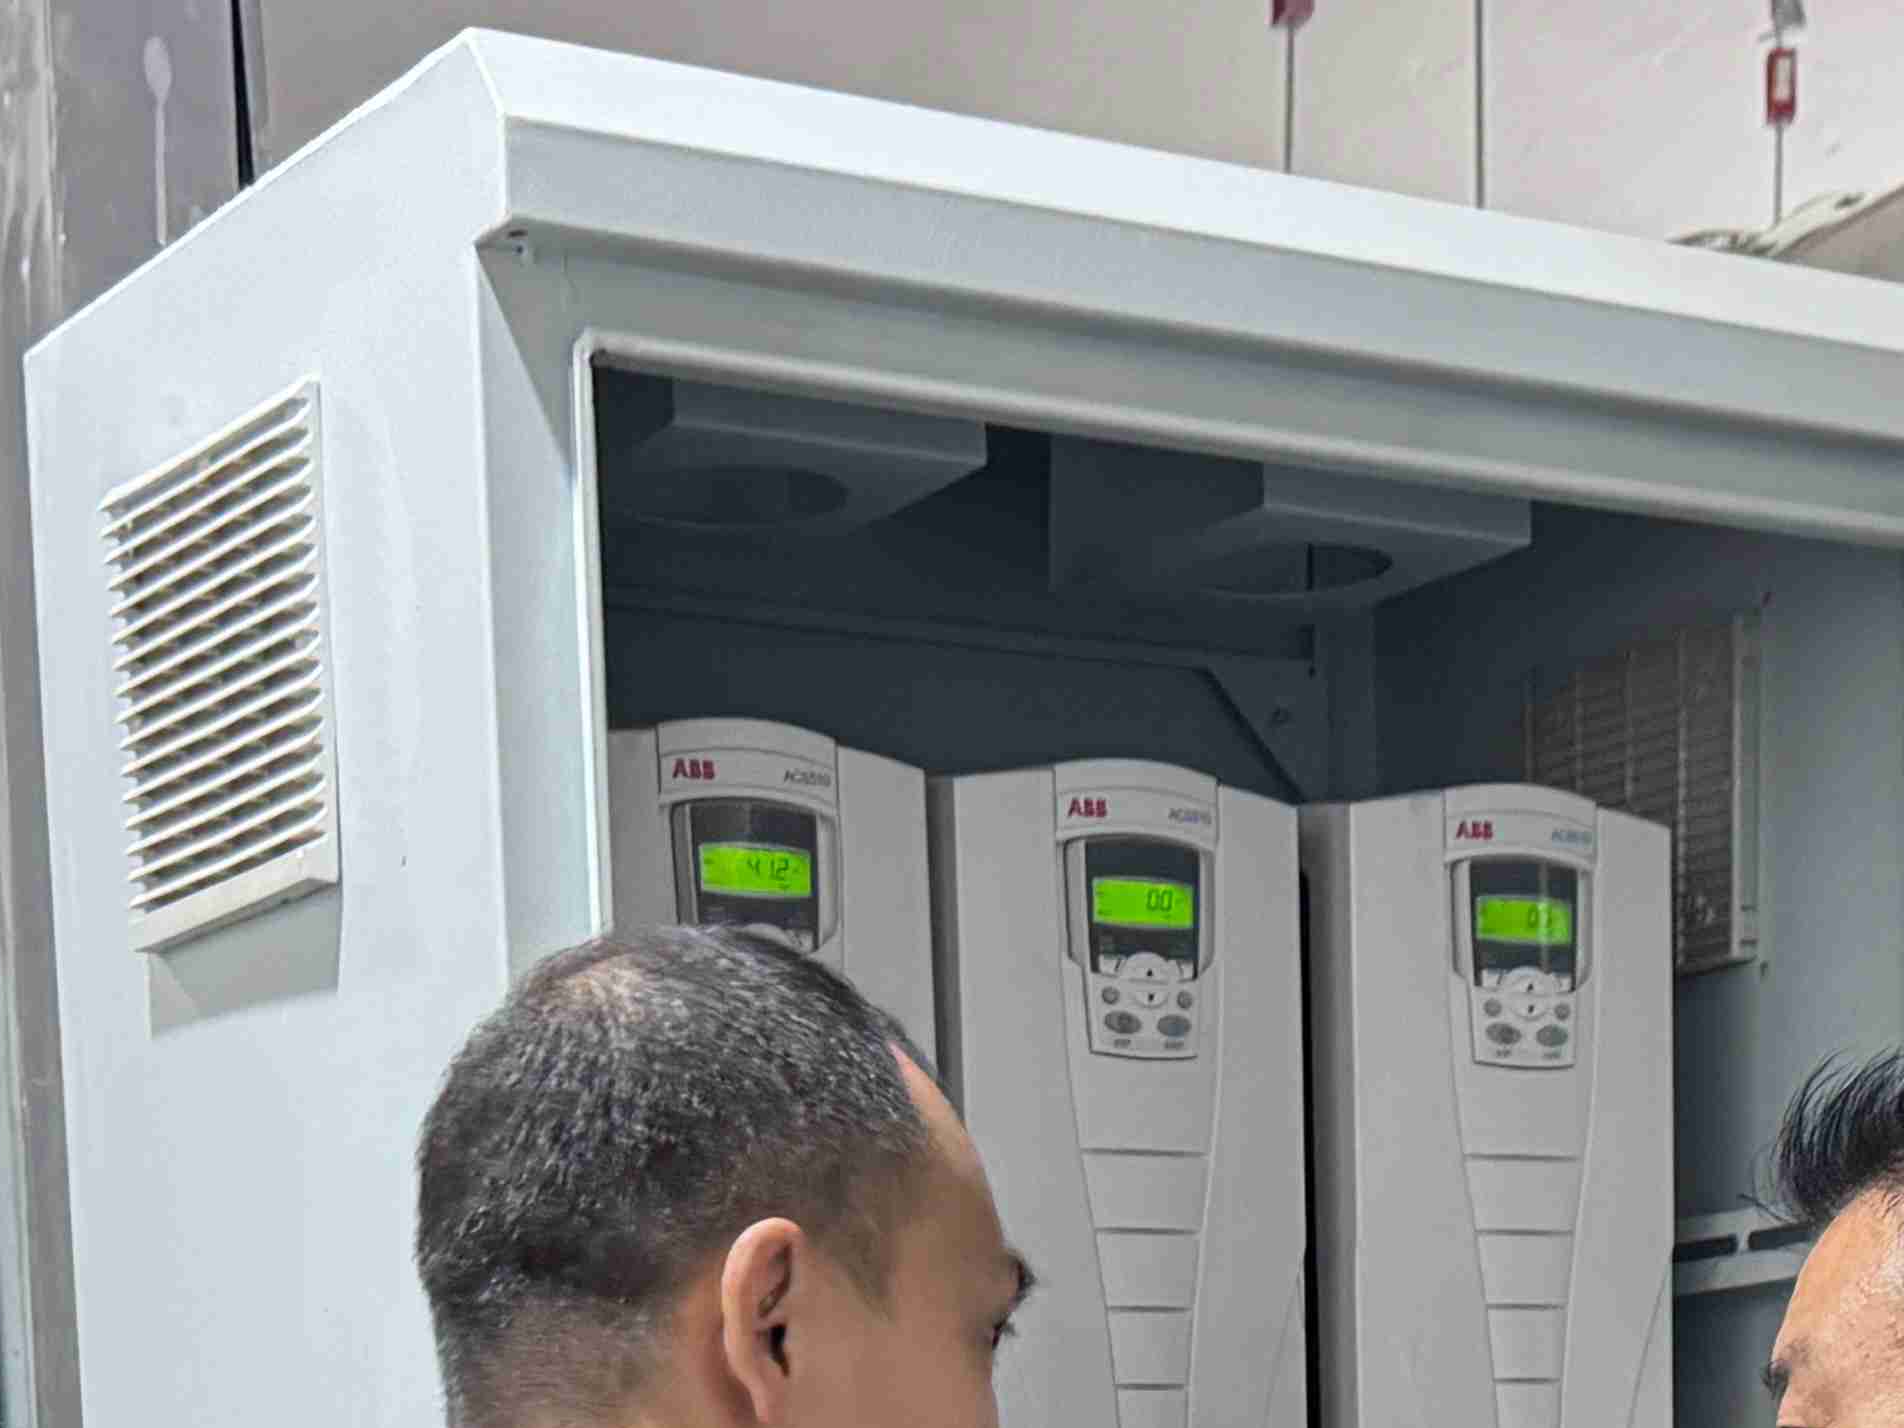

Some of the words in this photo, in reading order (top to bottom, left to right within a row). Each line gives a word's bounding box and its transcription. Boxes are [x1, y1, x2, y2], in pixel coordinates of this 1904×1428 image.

[672, 758, 715, 780] ABB
[1068, 798, 1108, 818] ABB
[1456, 820, 1493, 840] ABB
